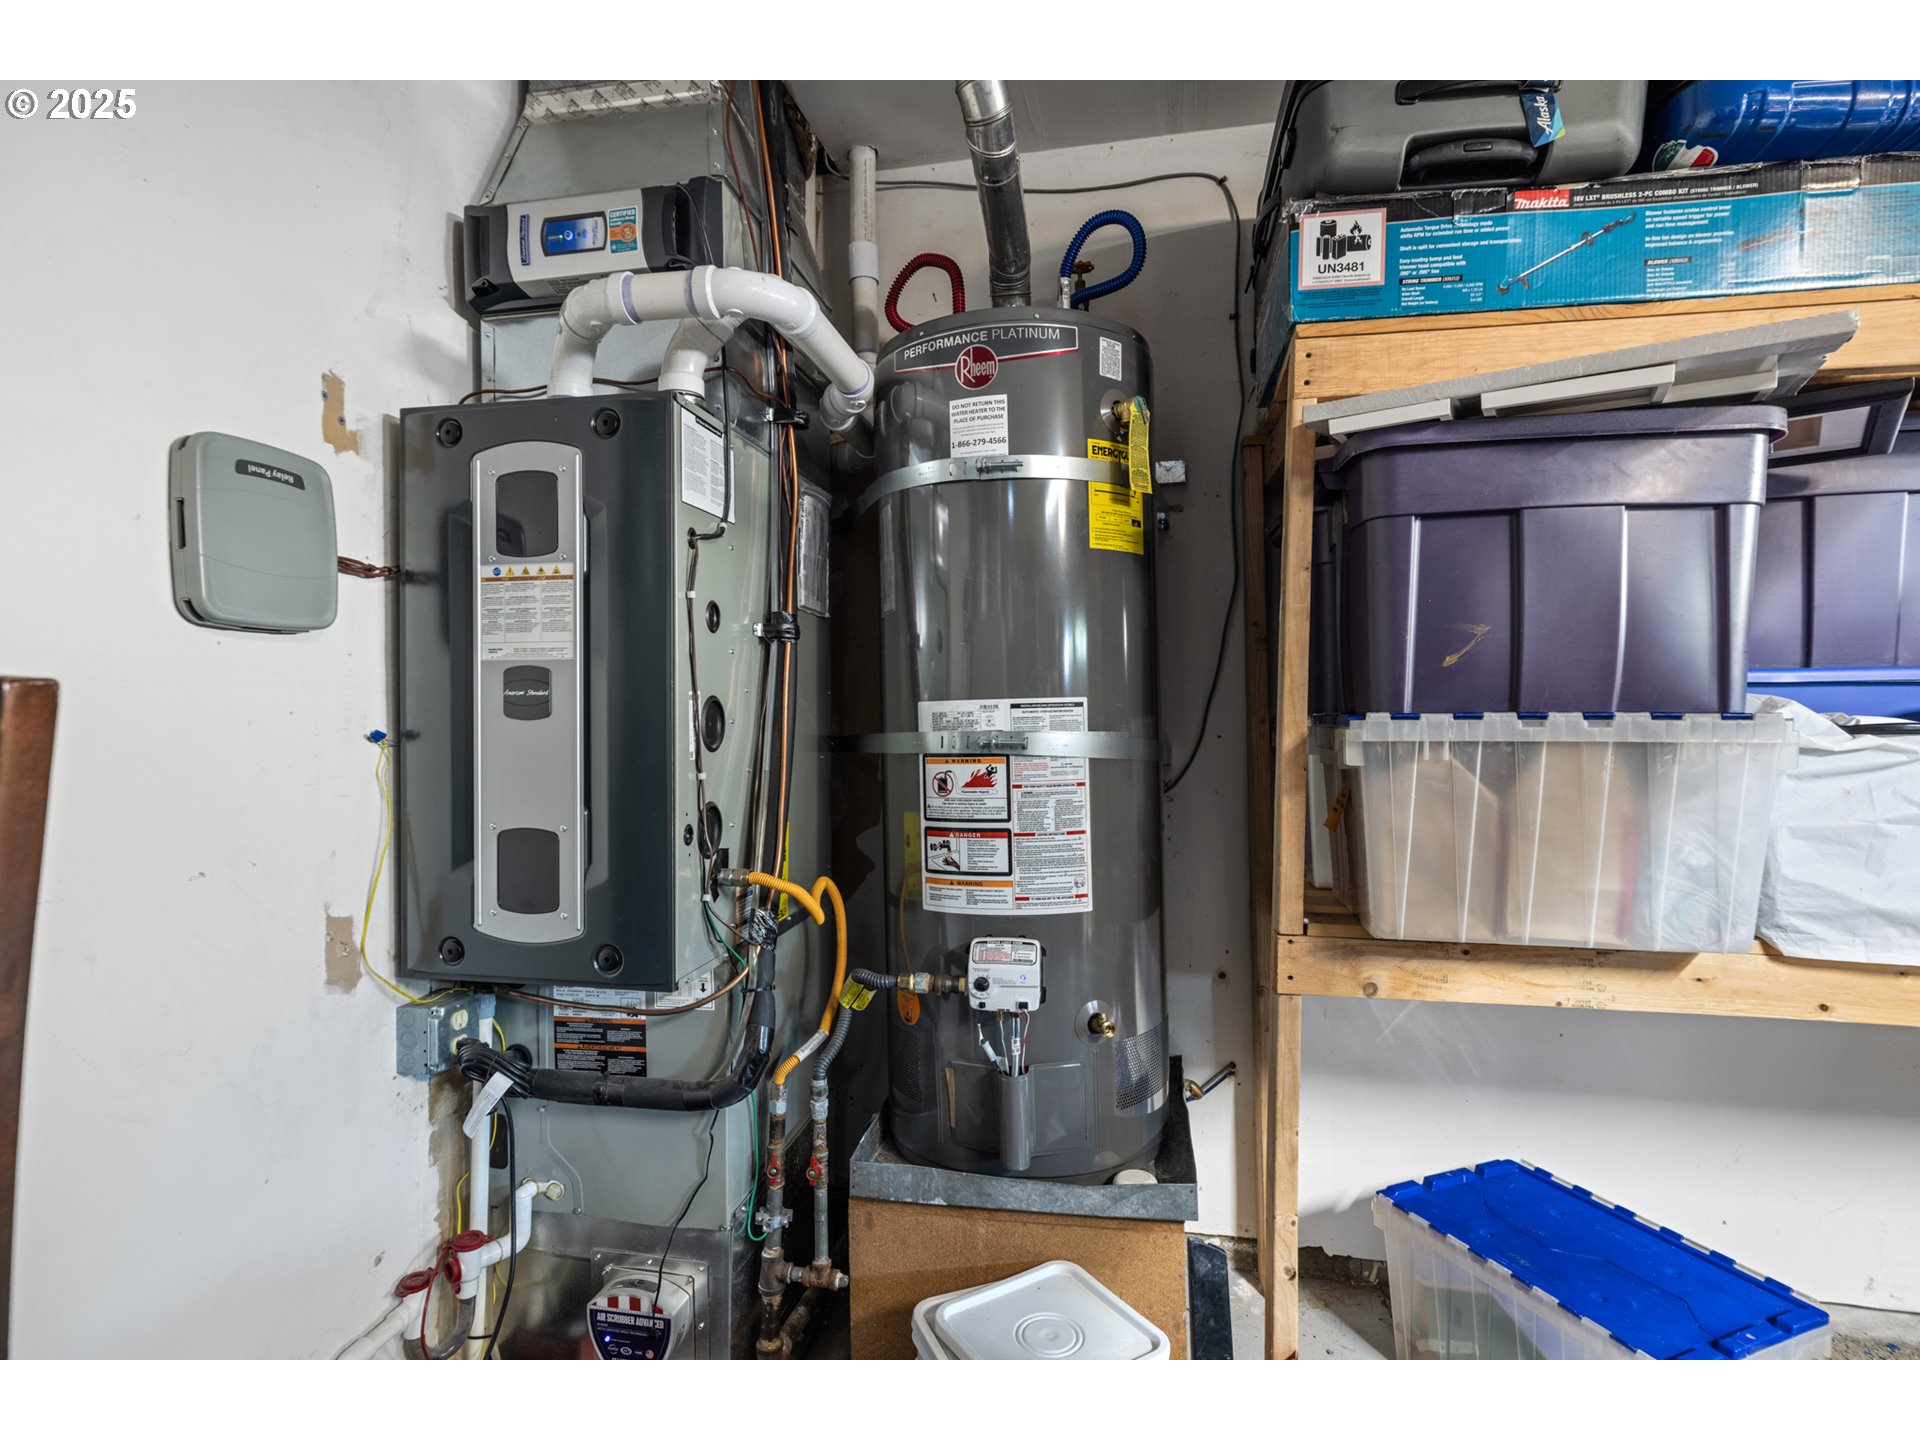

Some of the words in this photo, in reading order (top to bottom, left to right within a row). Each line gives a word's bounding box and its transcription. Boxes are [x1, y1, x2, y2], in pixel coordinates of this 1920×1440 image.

[1535, 94, 1552, 135] Alaska
[1602, 192, 1636, 200] BRUSHLESS
[610, 209, 636, 218] CERTIFIED
[1318, 262, 1364, 274] UN3481
[904, 330, 988, 360] PERFORMANCE
[992, 328, 1060, 340] PLATINUM
[960, 348, 996, 382] Rheem
[952, 437, 1006, 449] 1-866-279-4566
[247, 465, 271, 478] Panel
[272, 469, 294, 483] Relay
[504, 688, 525, 696] American
[597, 1312, 606, 1322] AIR
[607, 1314, 635, 1325] SCRUBBER
